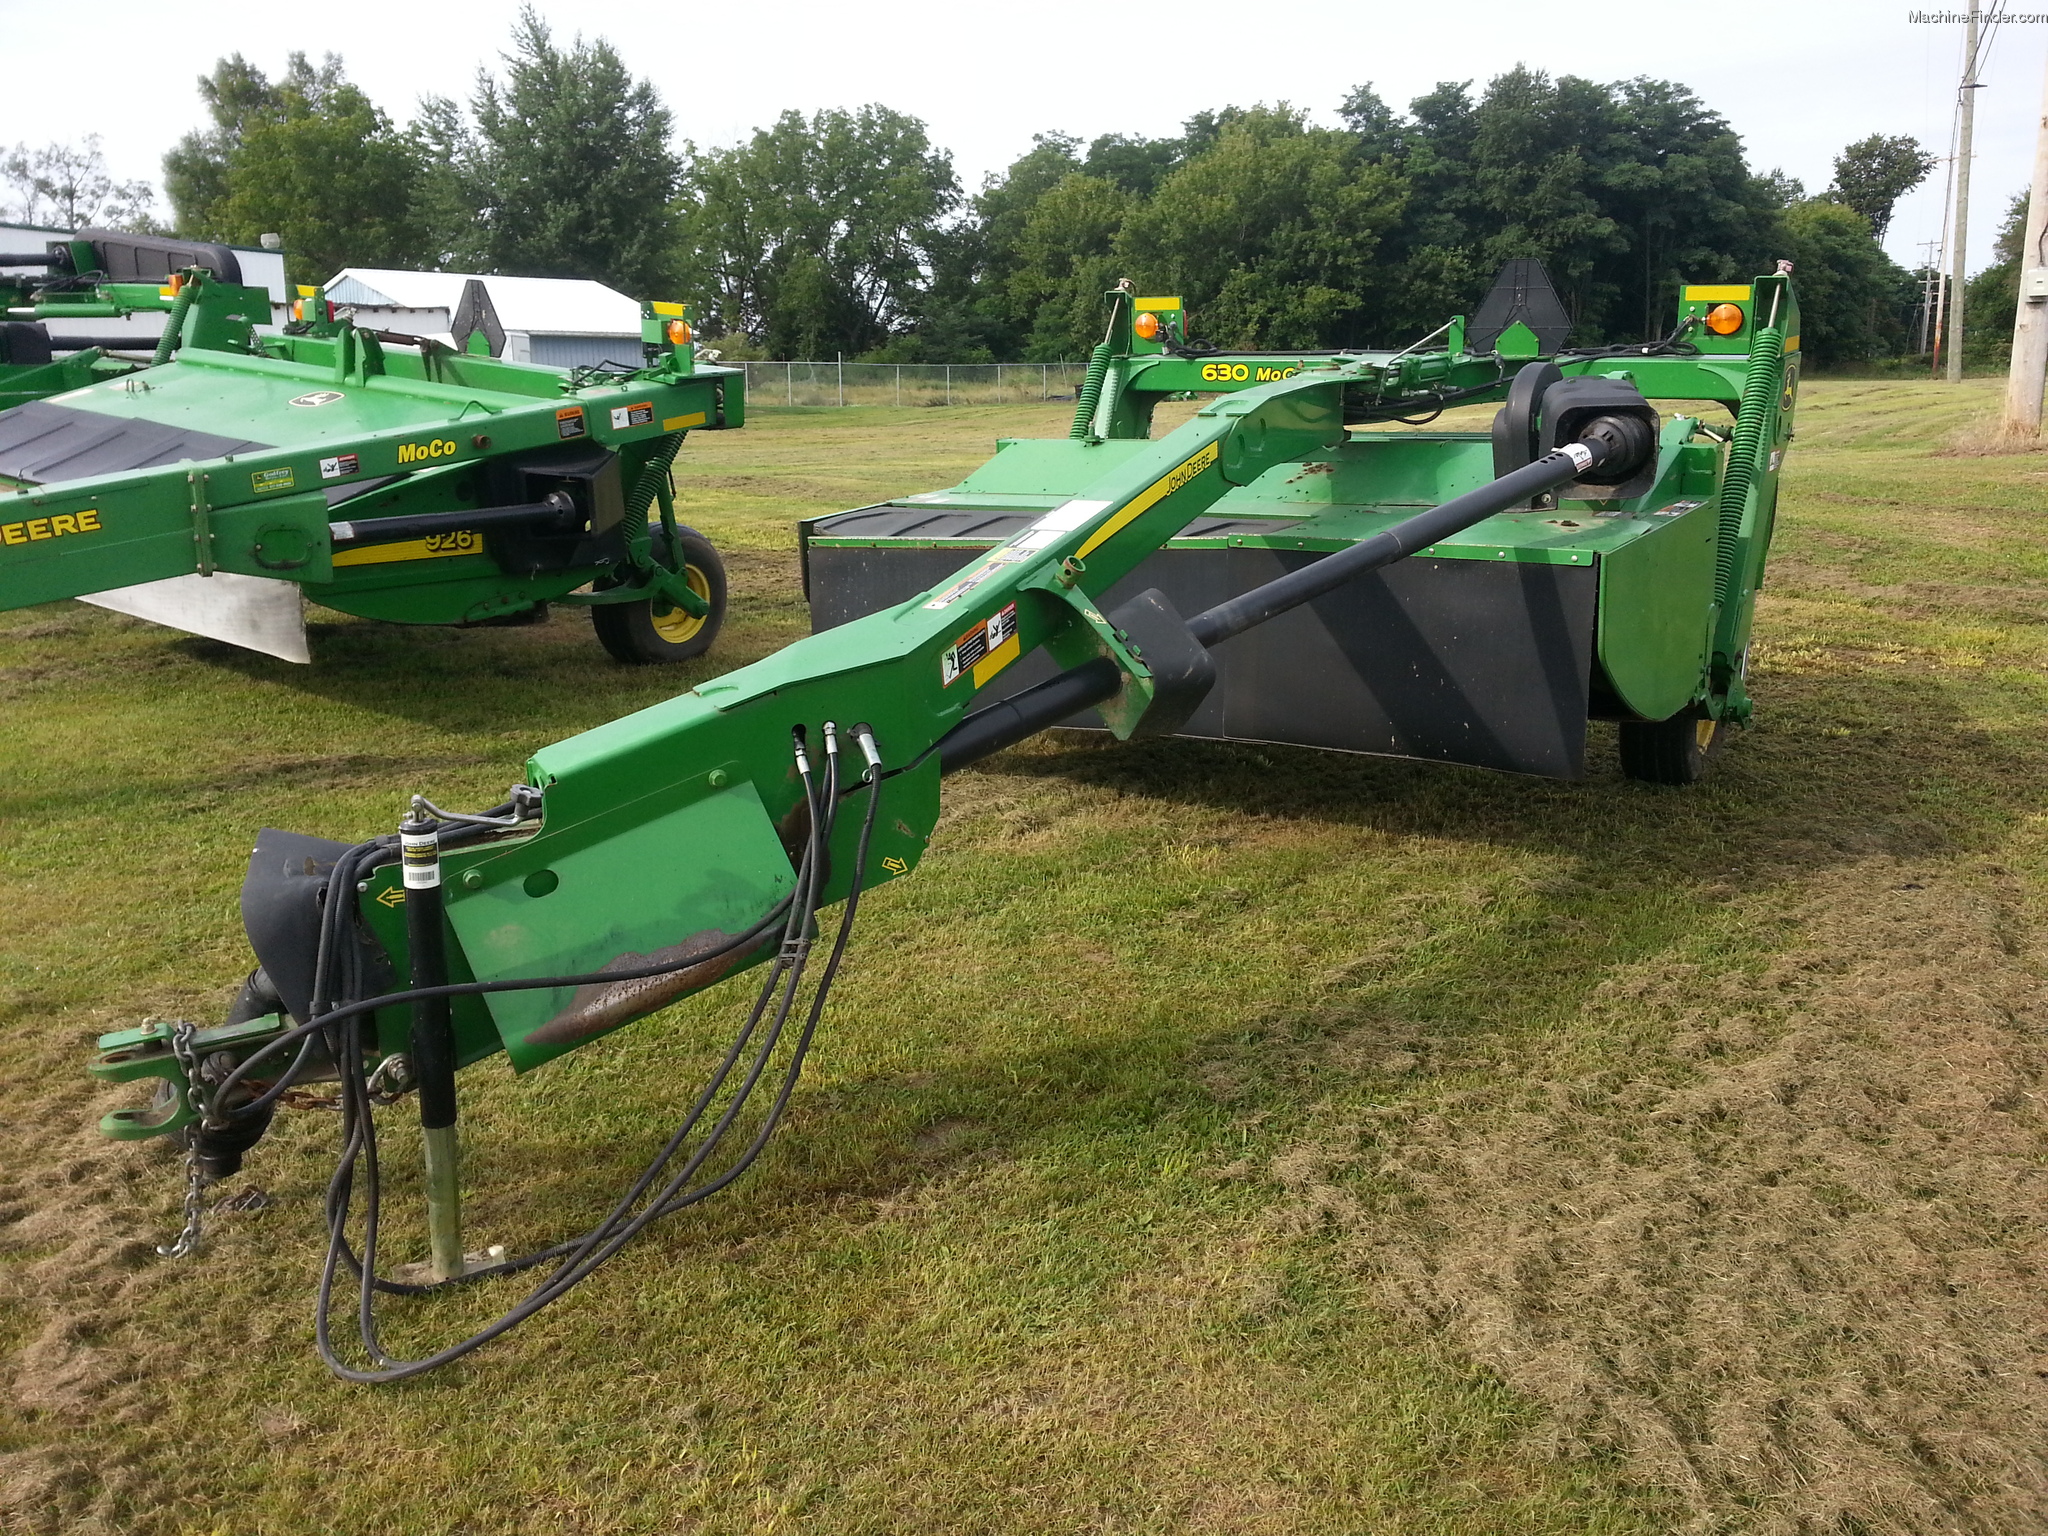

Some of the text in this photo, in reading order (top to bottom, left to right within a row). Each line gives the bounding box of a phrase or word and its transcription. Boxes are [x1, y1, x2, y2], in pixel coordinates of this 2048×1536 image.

[1201, 363, 1296, 382] 630 MoC
[397, 438, 457, 464] MoCo
[1186, 452, 1212, 480] DEERE
[0, 508, 102, 546] EERE
[425, 530, 473, 551] 926
